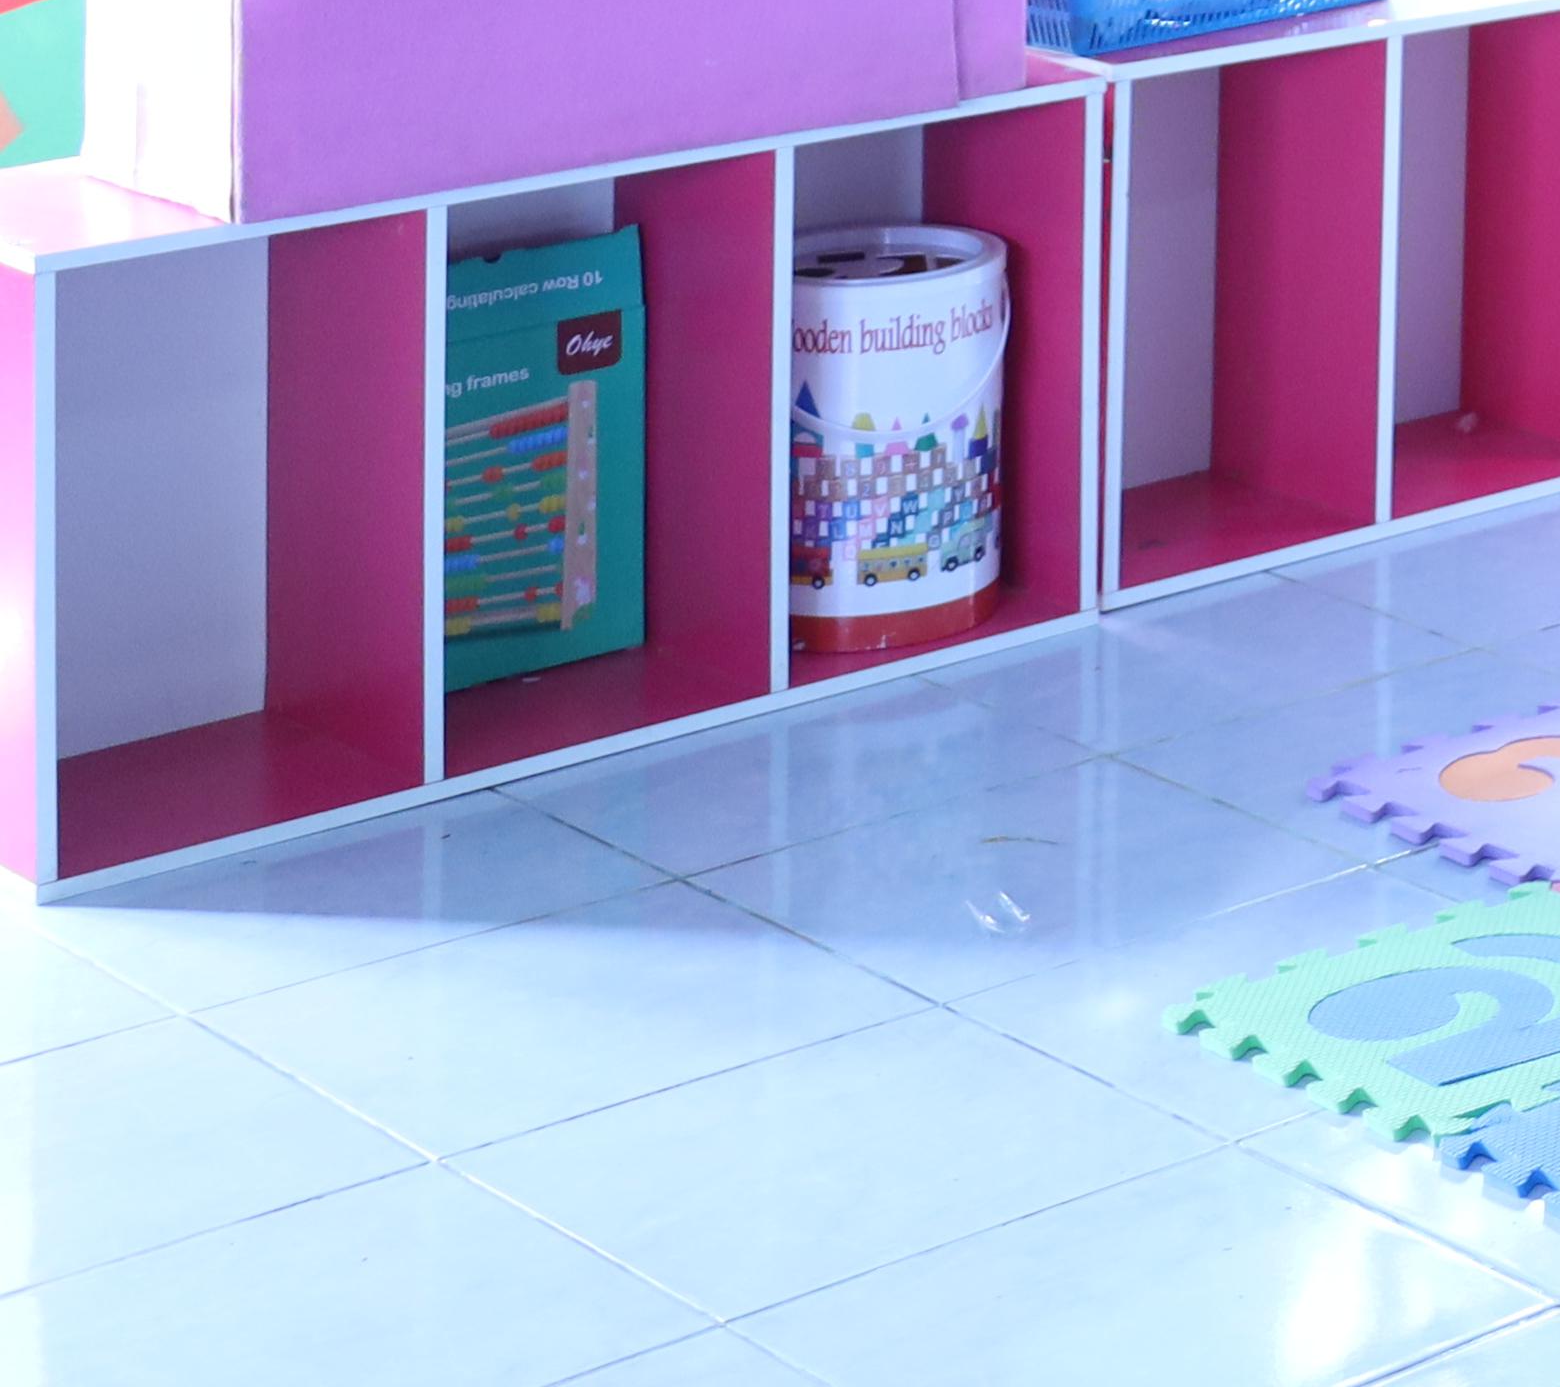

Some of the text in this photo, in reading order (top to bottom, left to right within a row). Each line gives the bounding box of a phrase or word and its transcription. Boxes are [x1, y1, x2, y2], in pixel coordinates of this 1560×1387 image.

[447, 270, 603, 310] 10 Row calculating
[792, 319, 853, 353] ooden
[860, 314, 946, 355] building
[467, 368, 529, 391] frames
